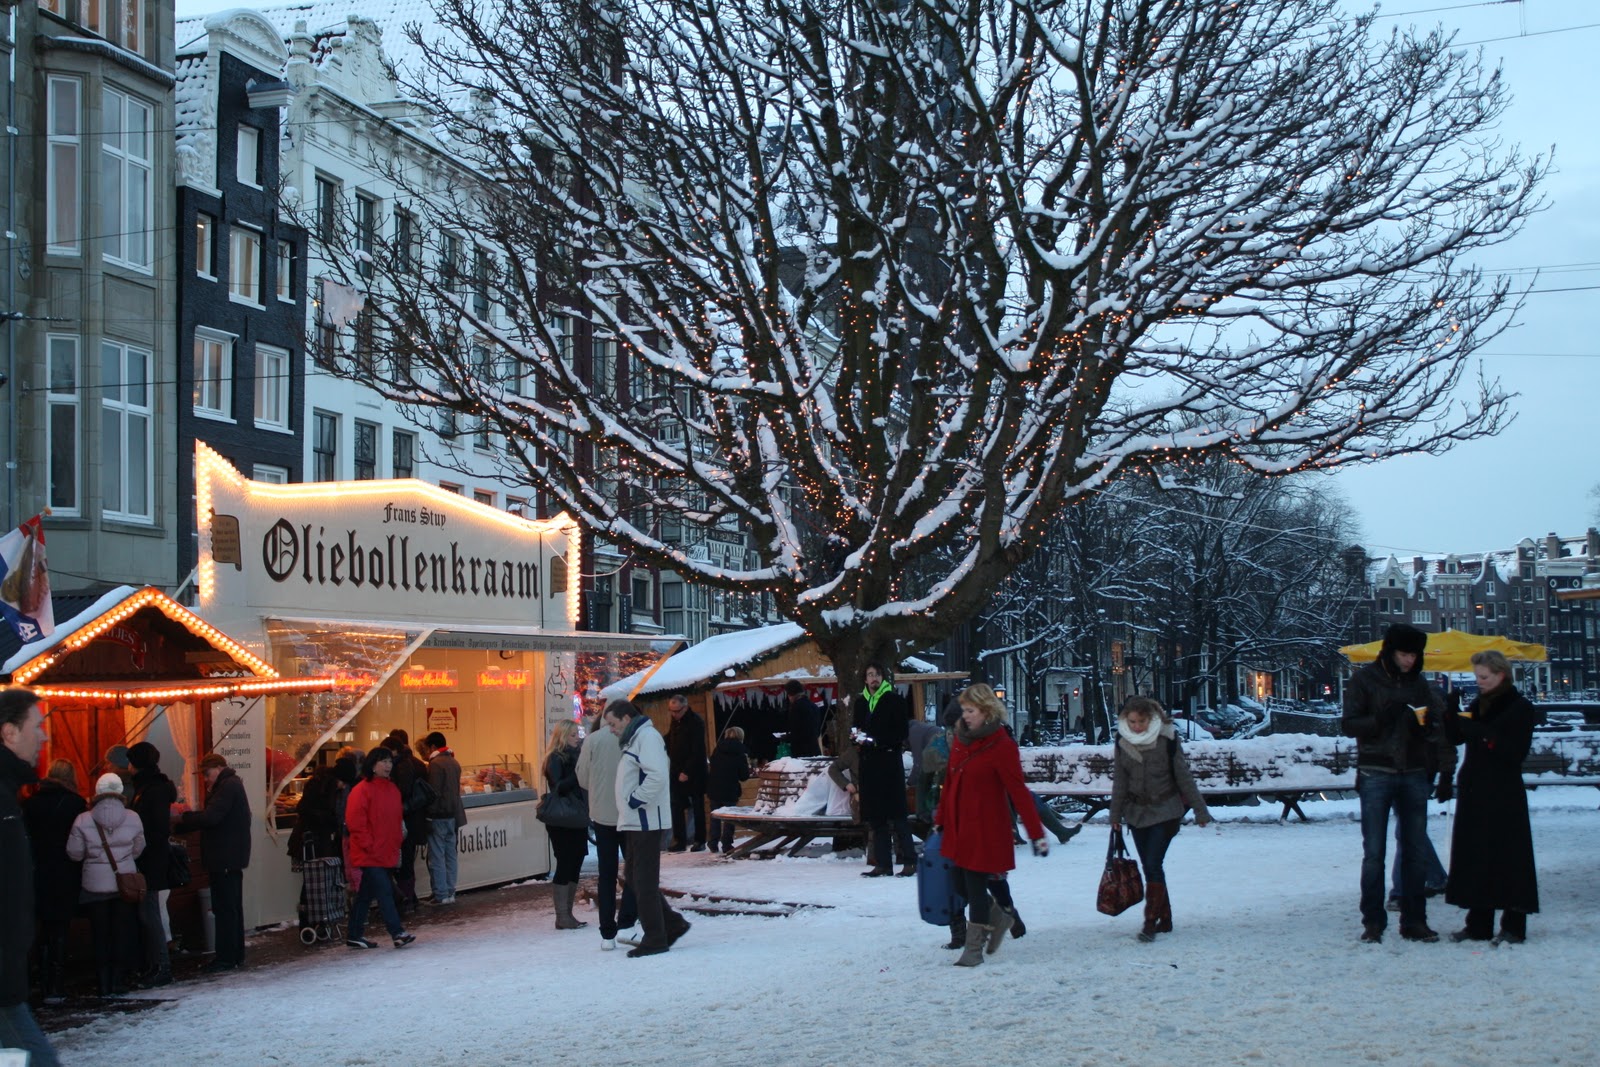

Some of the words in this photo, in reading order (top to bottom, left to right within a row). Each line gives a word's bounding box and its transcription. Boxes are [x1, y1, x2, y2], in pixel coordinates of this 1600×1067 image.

[383, 502, 416, 523] Frans
[262, 517, 540, 600] Oliebollenkraam
[457, 825, 508, 854] bakken
